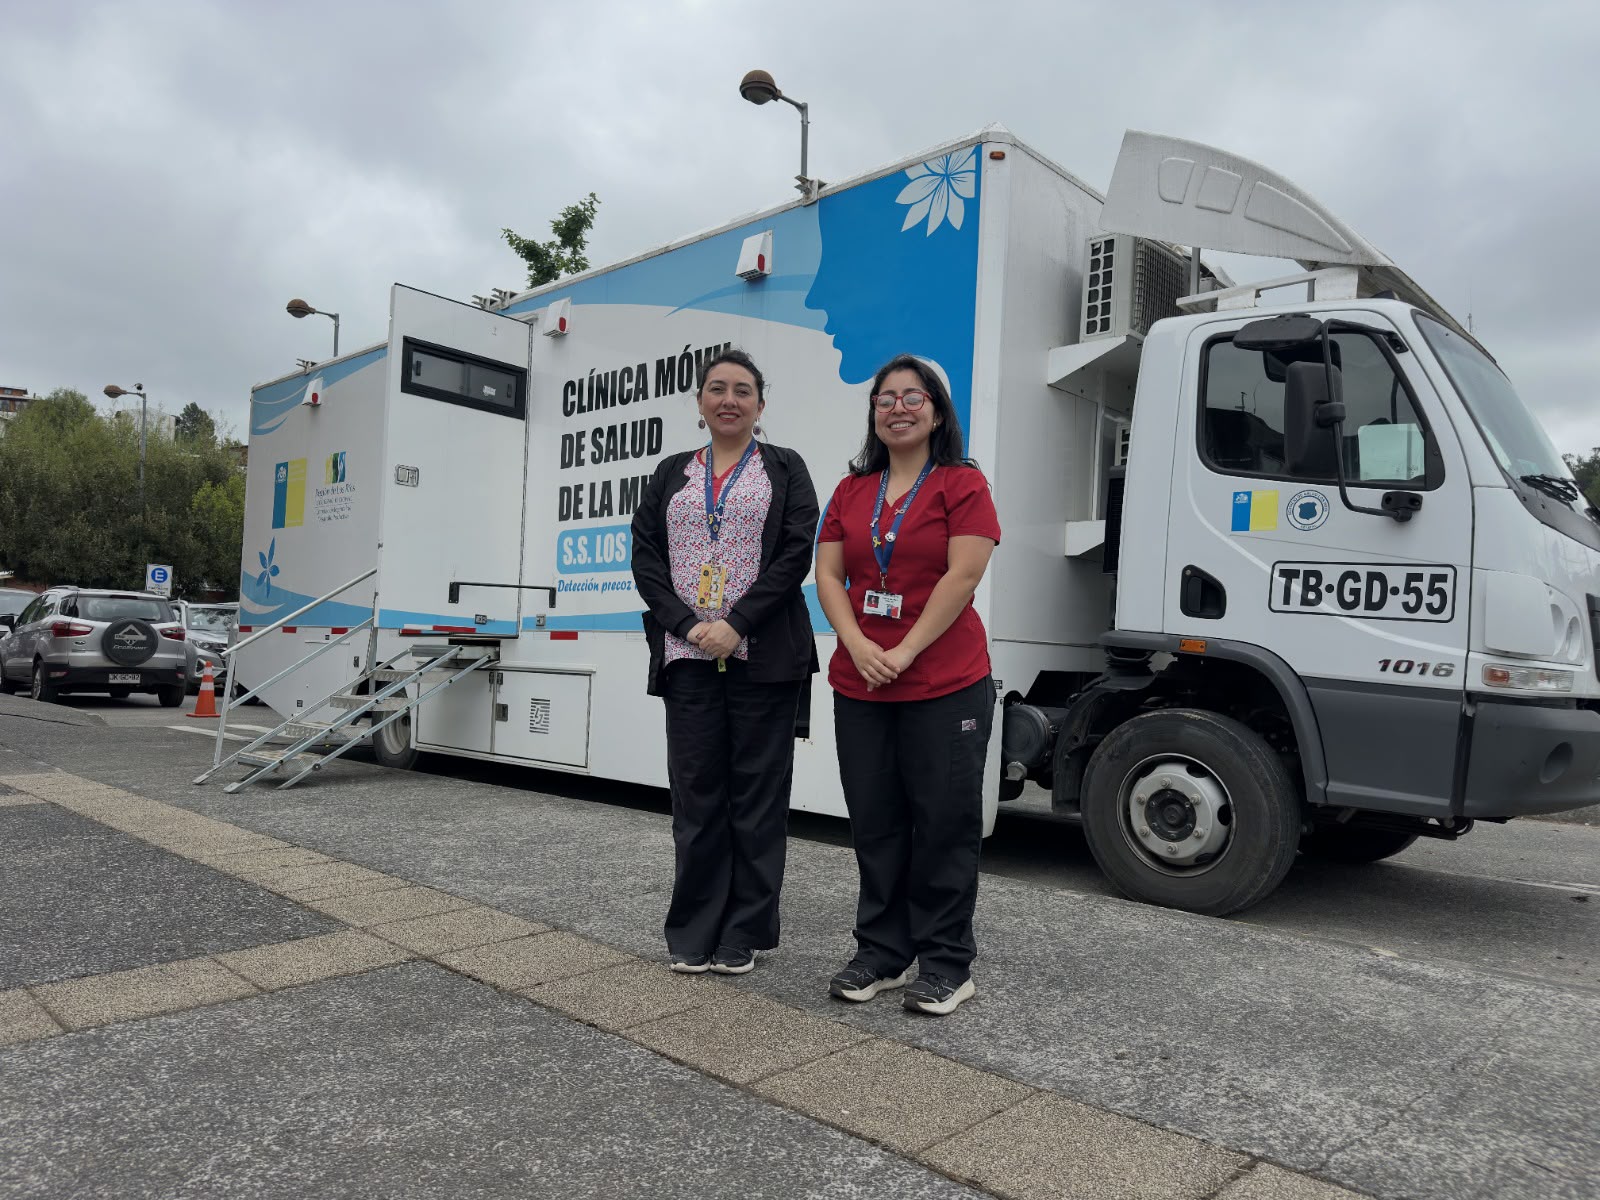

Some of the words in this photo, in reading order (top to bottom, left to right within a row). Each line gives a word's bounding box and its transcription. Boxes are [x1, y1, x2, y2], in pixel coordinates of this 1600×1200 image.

[562, 363, 649, 417] CLÍNICA
[654, 342, 732, 398] MÓV
[560, 431, 585, 469] DE
[591, 417, 663, 464] SALUD
[558, 483, 584, 521] DE
[588, 480, 614, 518] LA
[562, 535, 591, 565] S.S.
[595, 532, 626, 563] LOS
[155, 570, 164, 581] E
[557, 578, 599, 592] Detección
[601, 580, 632, 594] precoz
[1378, 658, 1455, 677] 1016
